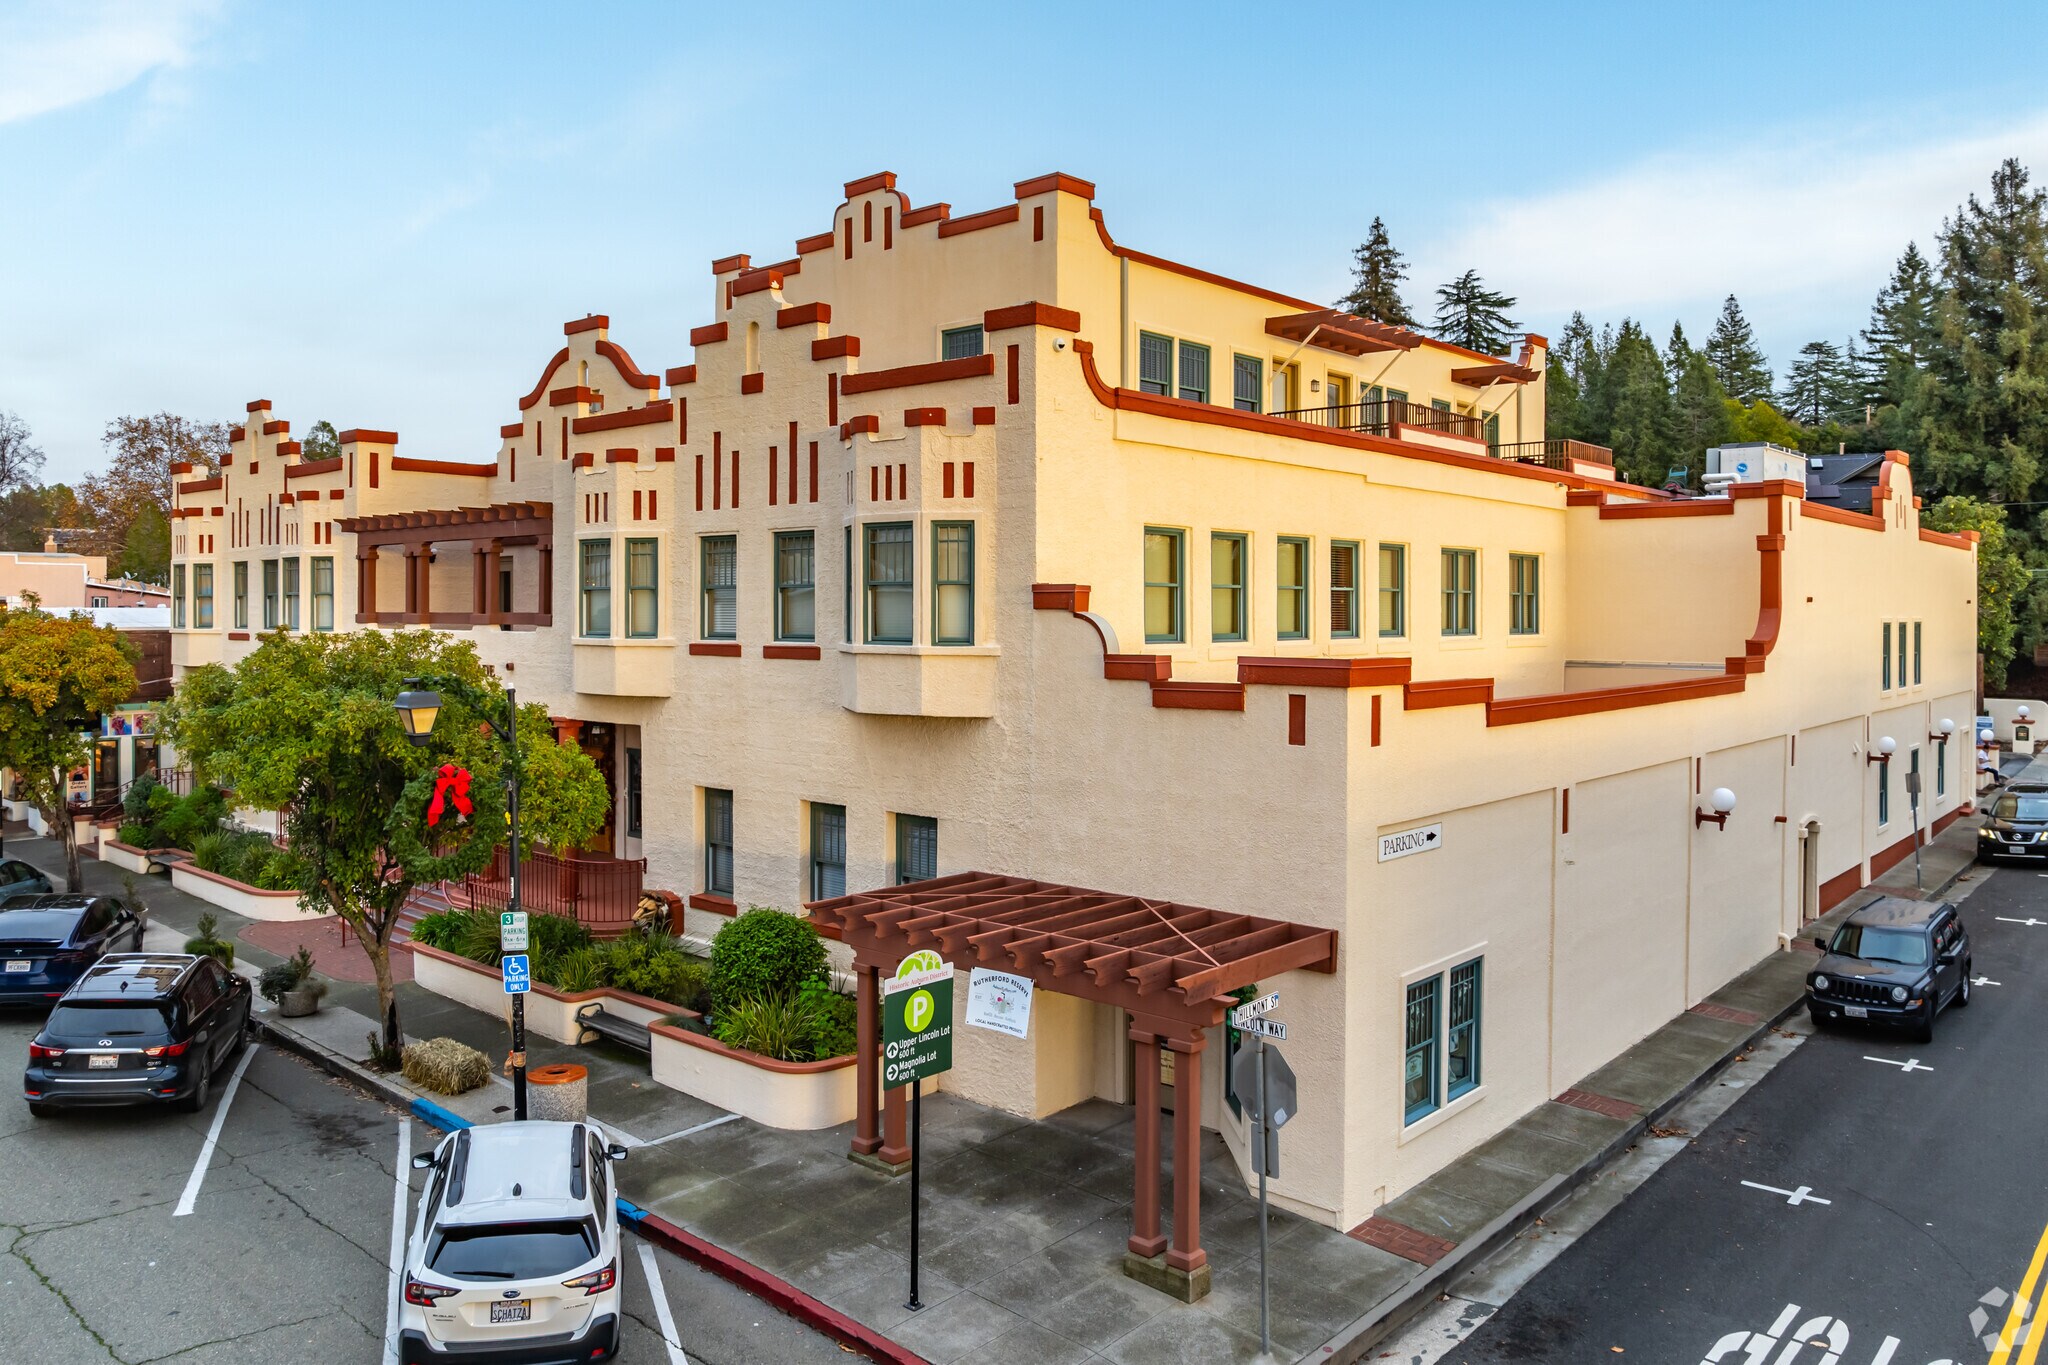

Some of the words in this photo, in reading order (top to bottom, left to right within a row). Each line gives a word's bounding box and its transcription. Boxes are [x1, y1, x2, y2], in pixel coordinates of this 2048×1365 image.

[1383, 831, 1425, 856] PARKING
[505, 915, 511, 924] 3
[503, 927, 526, 935] PARKING
[505, 974, 529, 982] PARKING
[510, 983, 524, 991] ONLY
[889, 981, 910, 991] Historic
[911, 976, 930, 985] Auburn
[930, 971, 949, 980] District
[973, 975, 1010, 987] RUTHERFORD
[1011, 979, 1029, 998] RESERVE
[913, 996, 928, 1027] P
[1239, 998, 1268, 1021] HILLMONT
[1233, 1013, 1265, 1033] LNCOLN
[1268, 1022, 1284, 1037] WAY
[899, 1036, 917, 1049] Upper
[918, 1029, 940, 1043] Lincoln
[940, 1025, 950, 1036] Lot
[899, 1048, 909, 1059] 600
[910, 1047, 915, 1055] ft
[899, 1055, 926, 1070] Magnolia
[927, 1050, 937, 1062] Lot
[899, 1070, 909, 1081] 600
[910, 1069, 915, 1077] ft
[493, 1307, 527, 1320] SCHATZA
